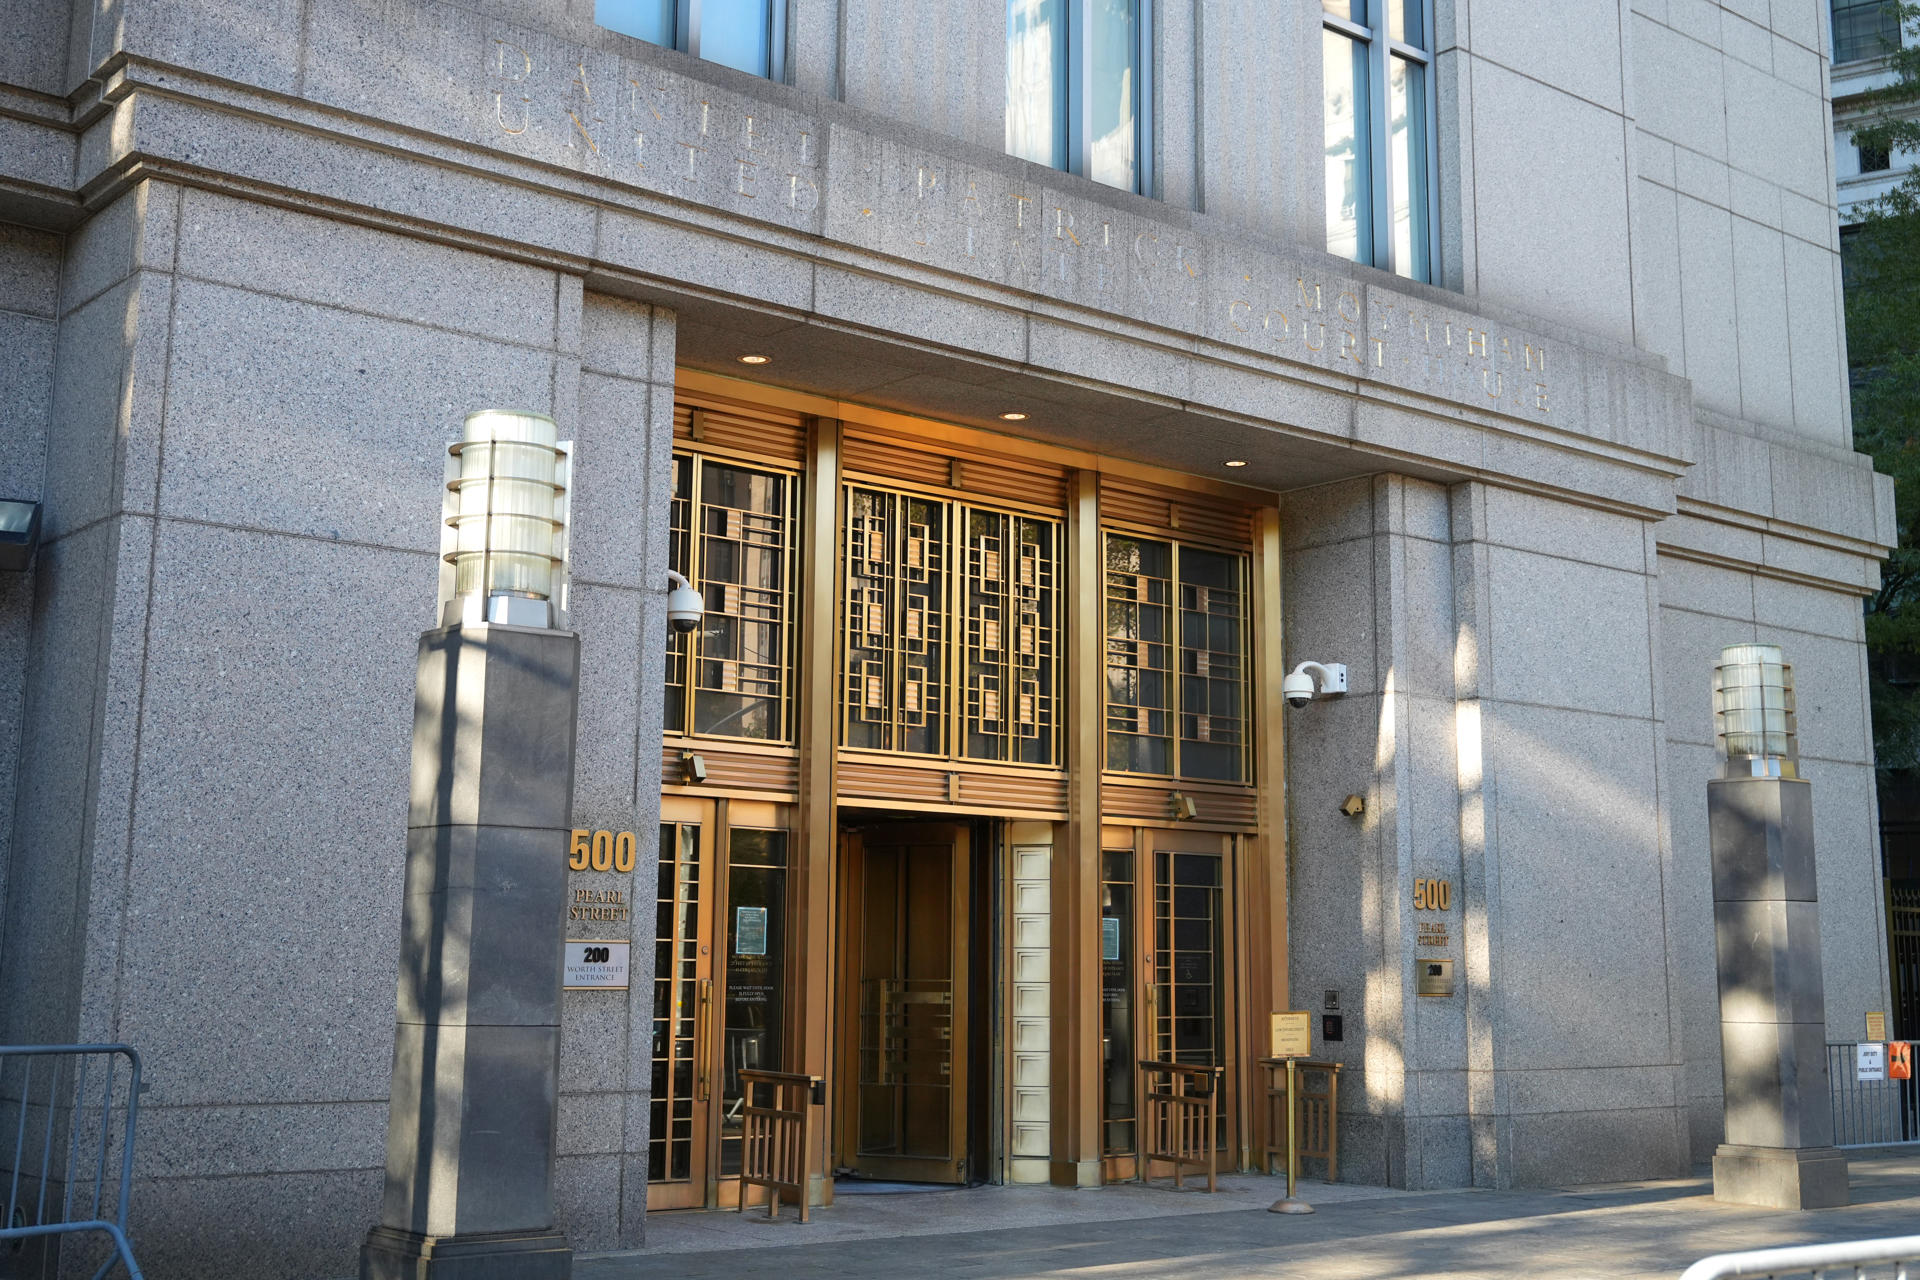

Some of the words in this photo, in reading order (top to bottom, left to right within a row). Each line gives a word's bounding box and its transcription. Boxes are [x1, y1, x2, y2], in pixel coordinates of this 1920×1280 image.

[491, 89, 819, 212] UNITED
[569, 829, 636, 873] 500
[575, 888, 625, 905] PEARL
[1413, 878, 1451, 911] 500
[569, 905, 629, 921] STREET
[583, 946, 610, 963] 200
[567, 965, 596, 973] WORTH
[598, 966, 624, 974] STREET
